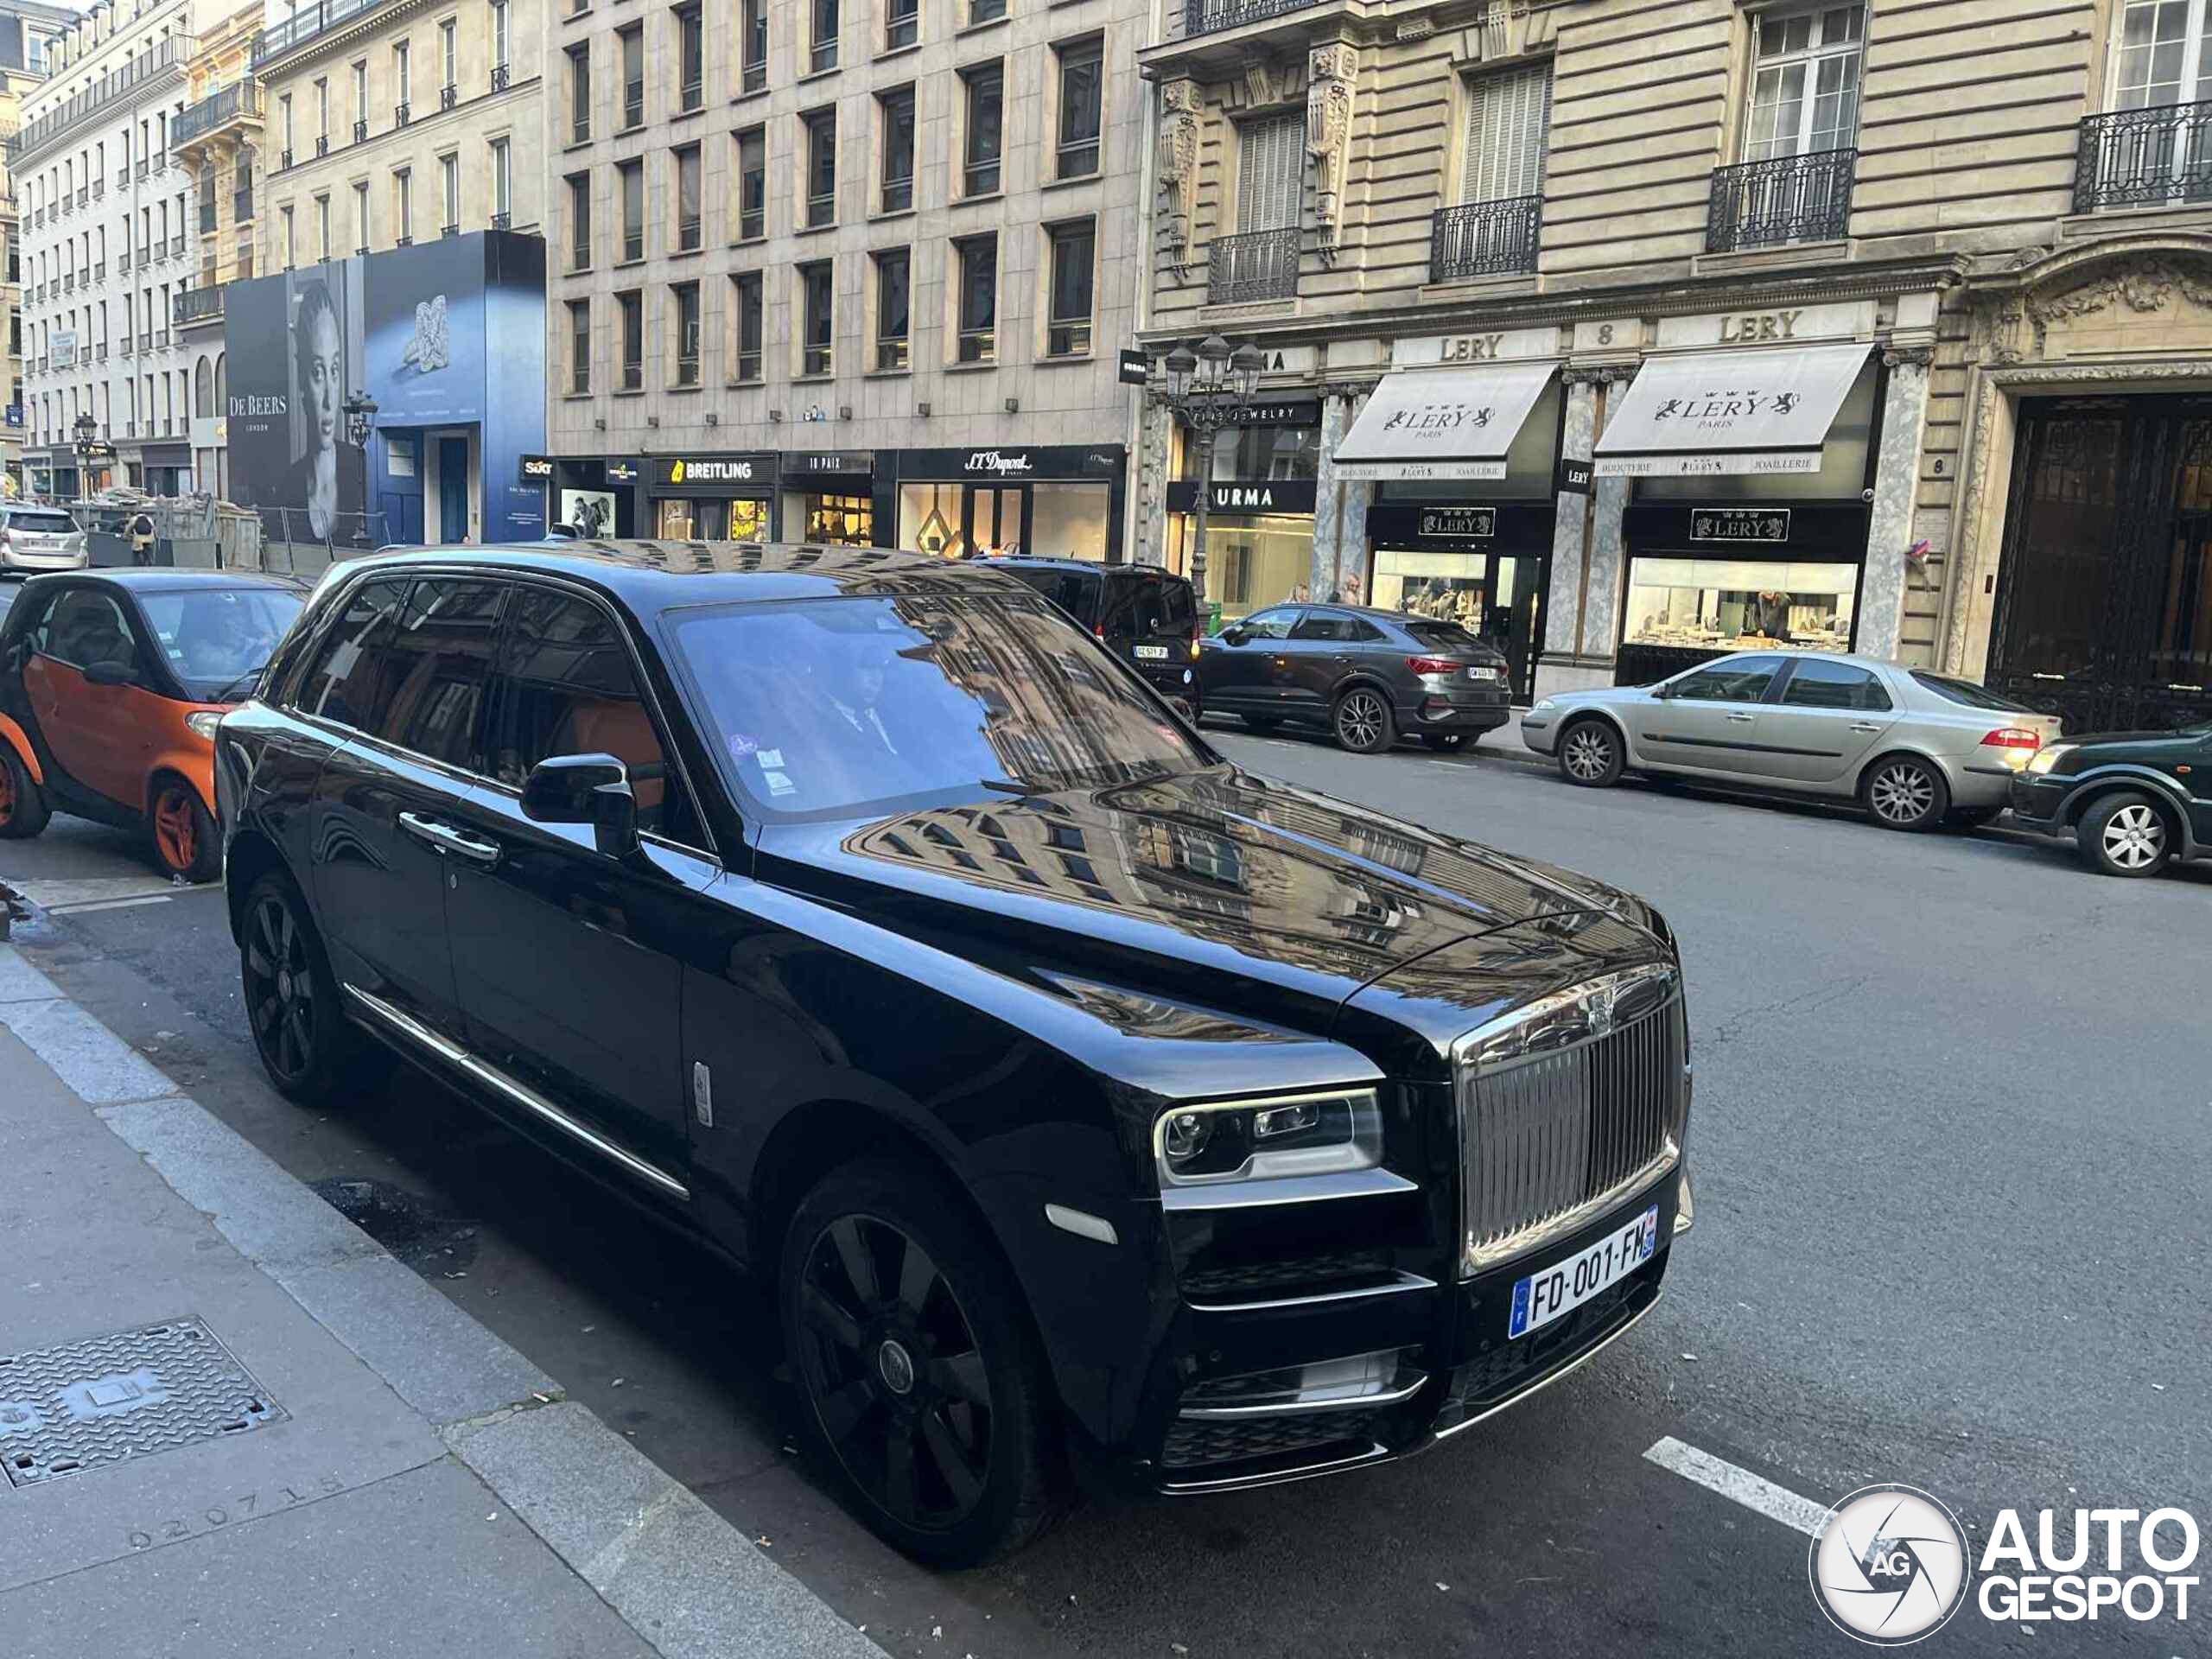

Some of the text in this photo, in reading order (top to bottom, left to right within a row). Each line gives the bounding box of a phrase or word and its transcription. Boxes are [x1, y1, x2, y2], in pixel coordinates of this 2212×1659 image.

[1599, 323, 1614, 346] 8
[1719, 309, 1802, 342] LERY
[1440, 334, 1503, 361] LERY
[230, 394, 287, 416] DE BEERS
[1680, 397, 1770, 418] LERY
[1404, 409, 1474, 429] LERY
[1698, 420, 1733, 429] PARIS
[686, 462, 752, 480] BREITLING
[822, 456, 841, 470] PAIX
[1934, 459, 1943, 474] 8
[1568, 469, 1588, 485] LERY
[1217, 487, 1273, 506] URMA
[1437, 517, 1480, 533] LERY
[1714, 520, 1766, 537] LERY
[1532, 1220, 1646, 1322] FD-001-FM
